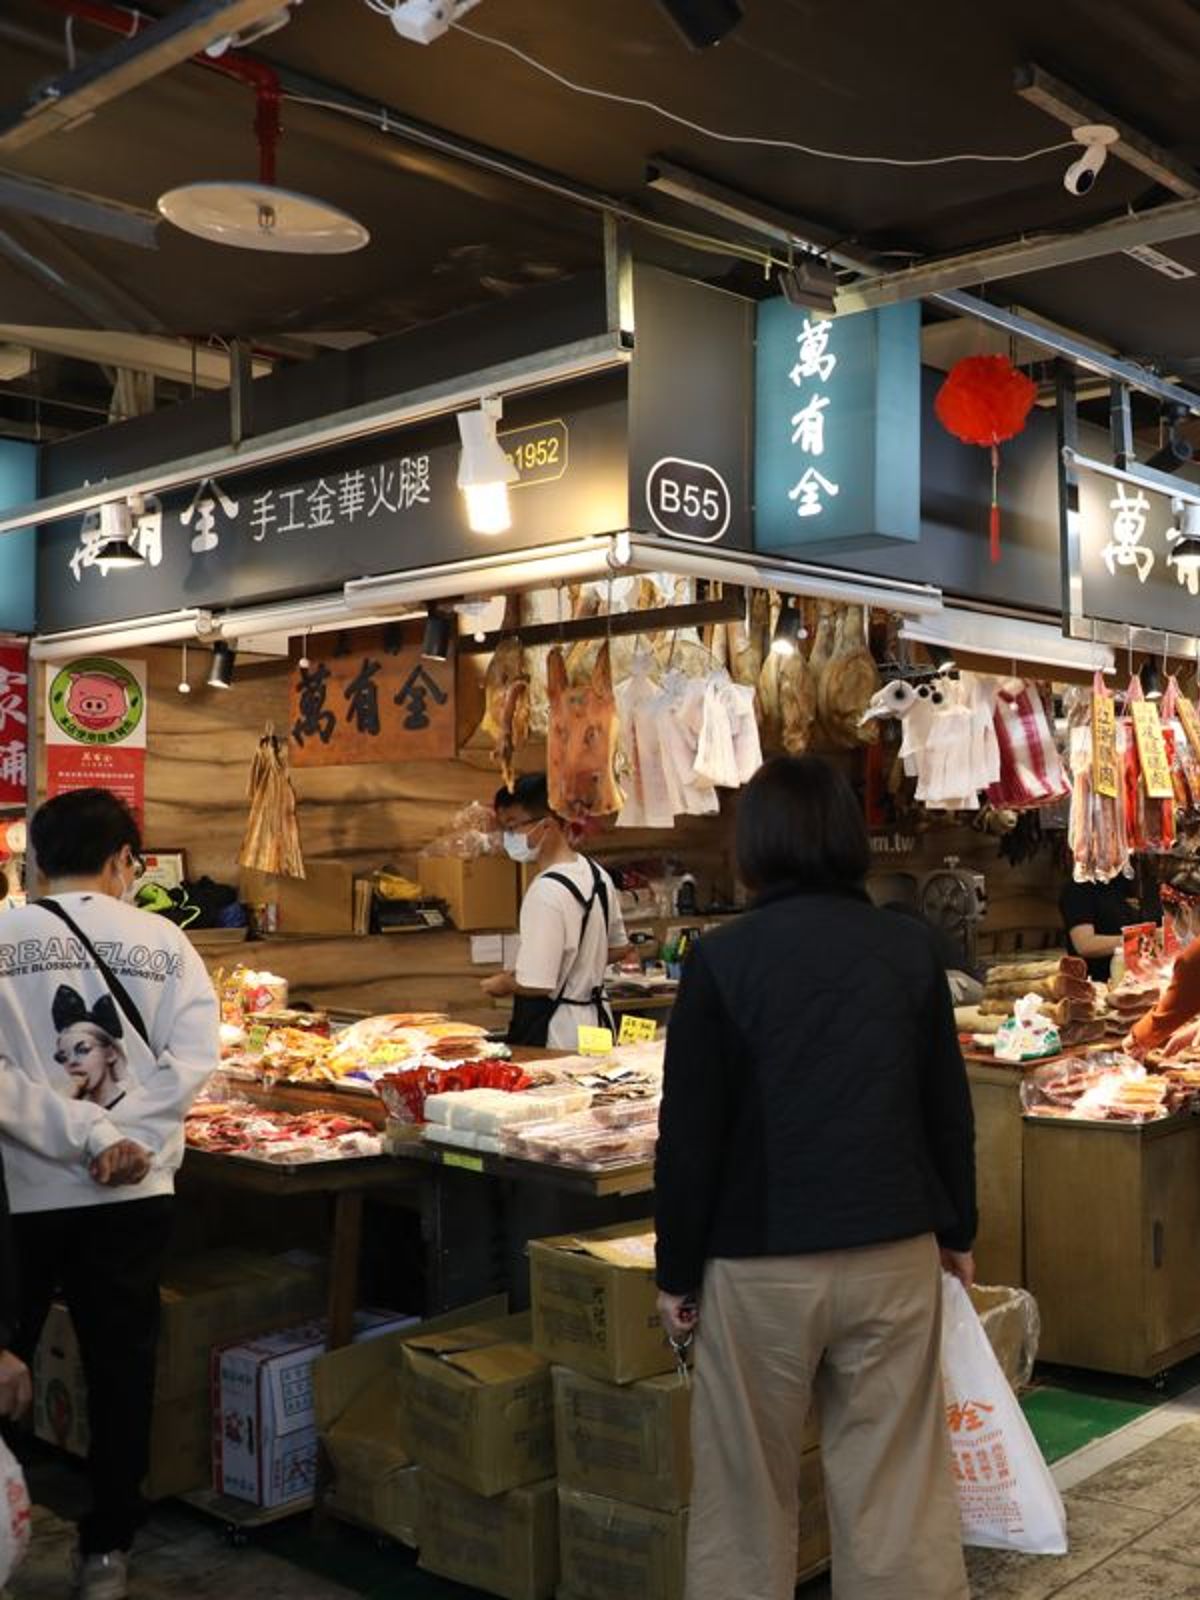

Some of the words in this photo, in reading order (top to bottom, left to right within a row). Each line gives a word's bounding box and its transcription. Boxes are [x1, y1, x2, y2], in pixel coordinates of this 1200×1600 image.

[788, 319, 839, 517] 萬有全
[249, 455, 431, 541] 手工金華火腿
[660, 478, 720, 521] B55
[292, 658, 448, 747] 萬有全
